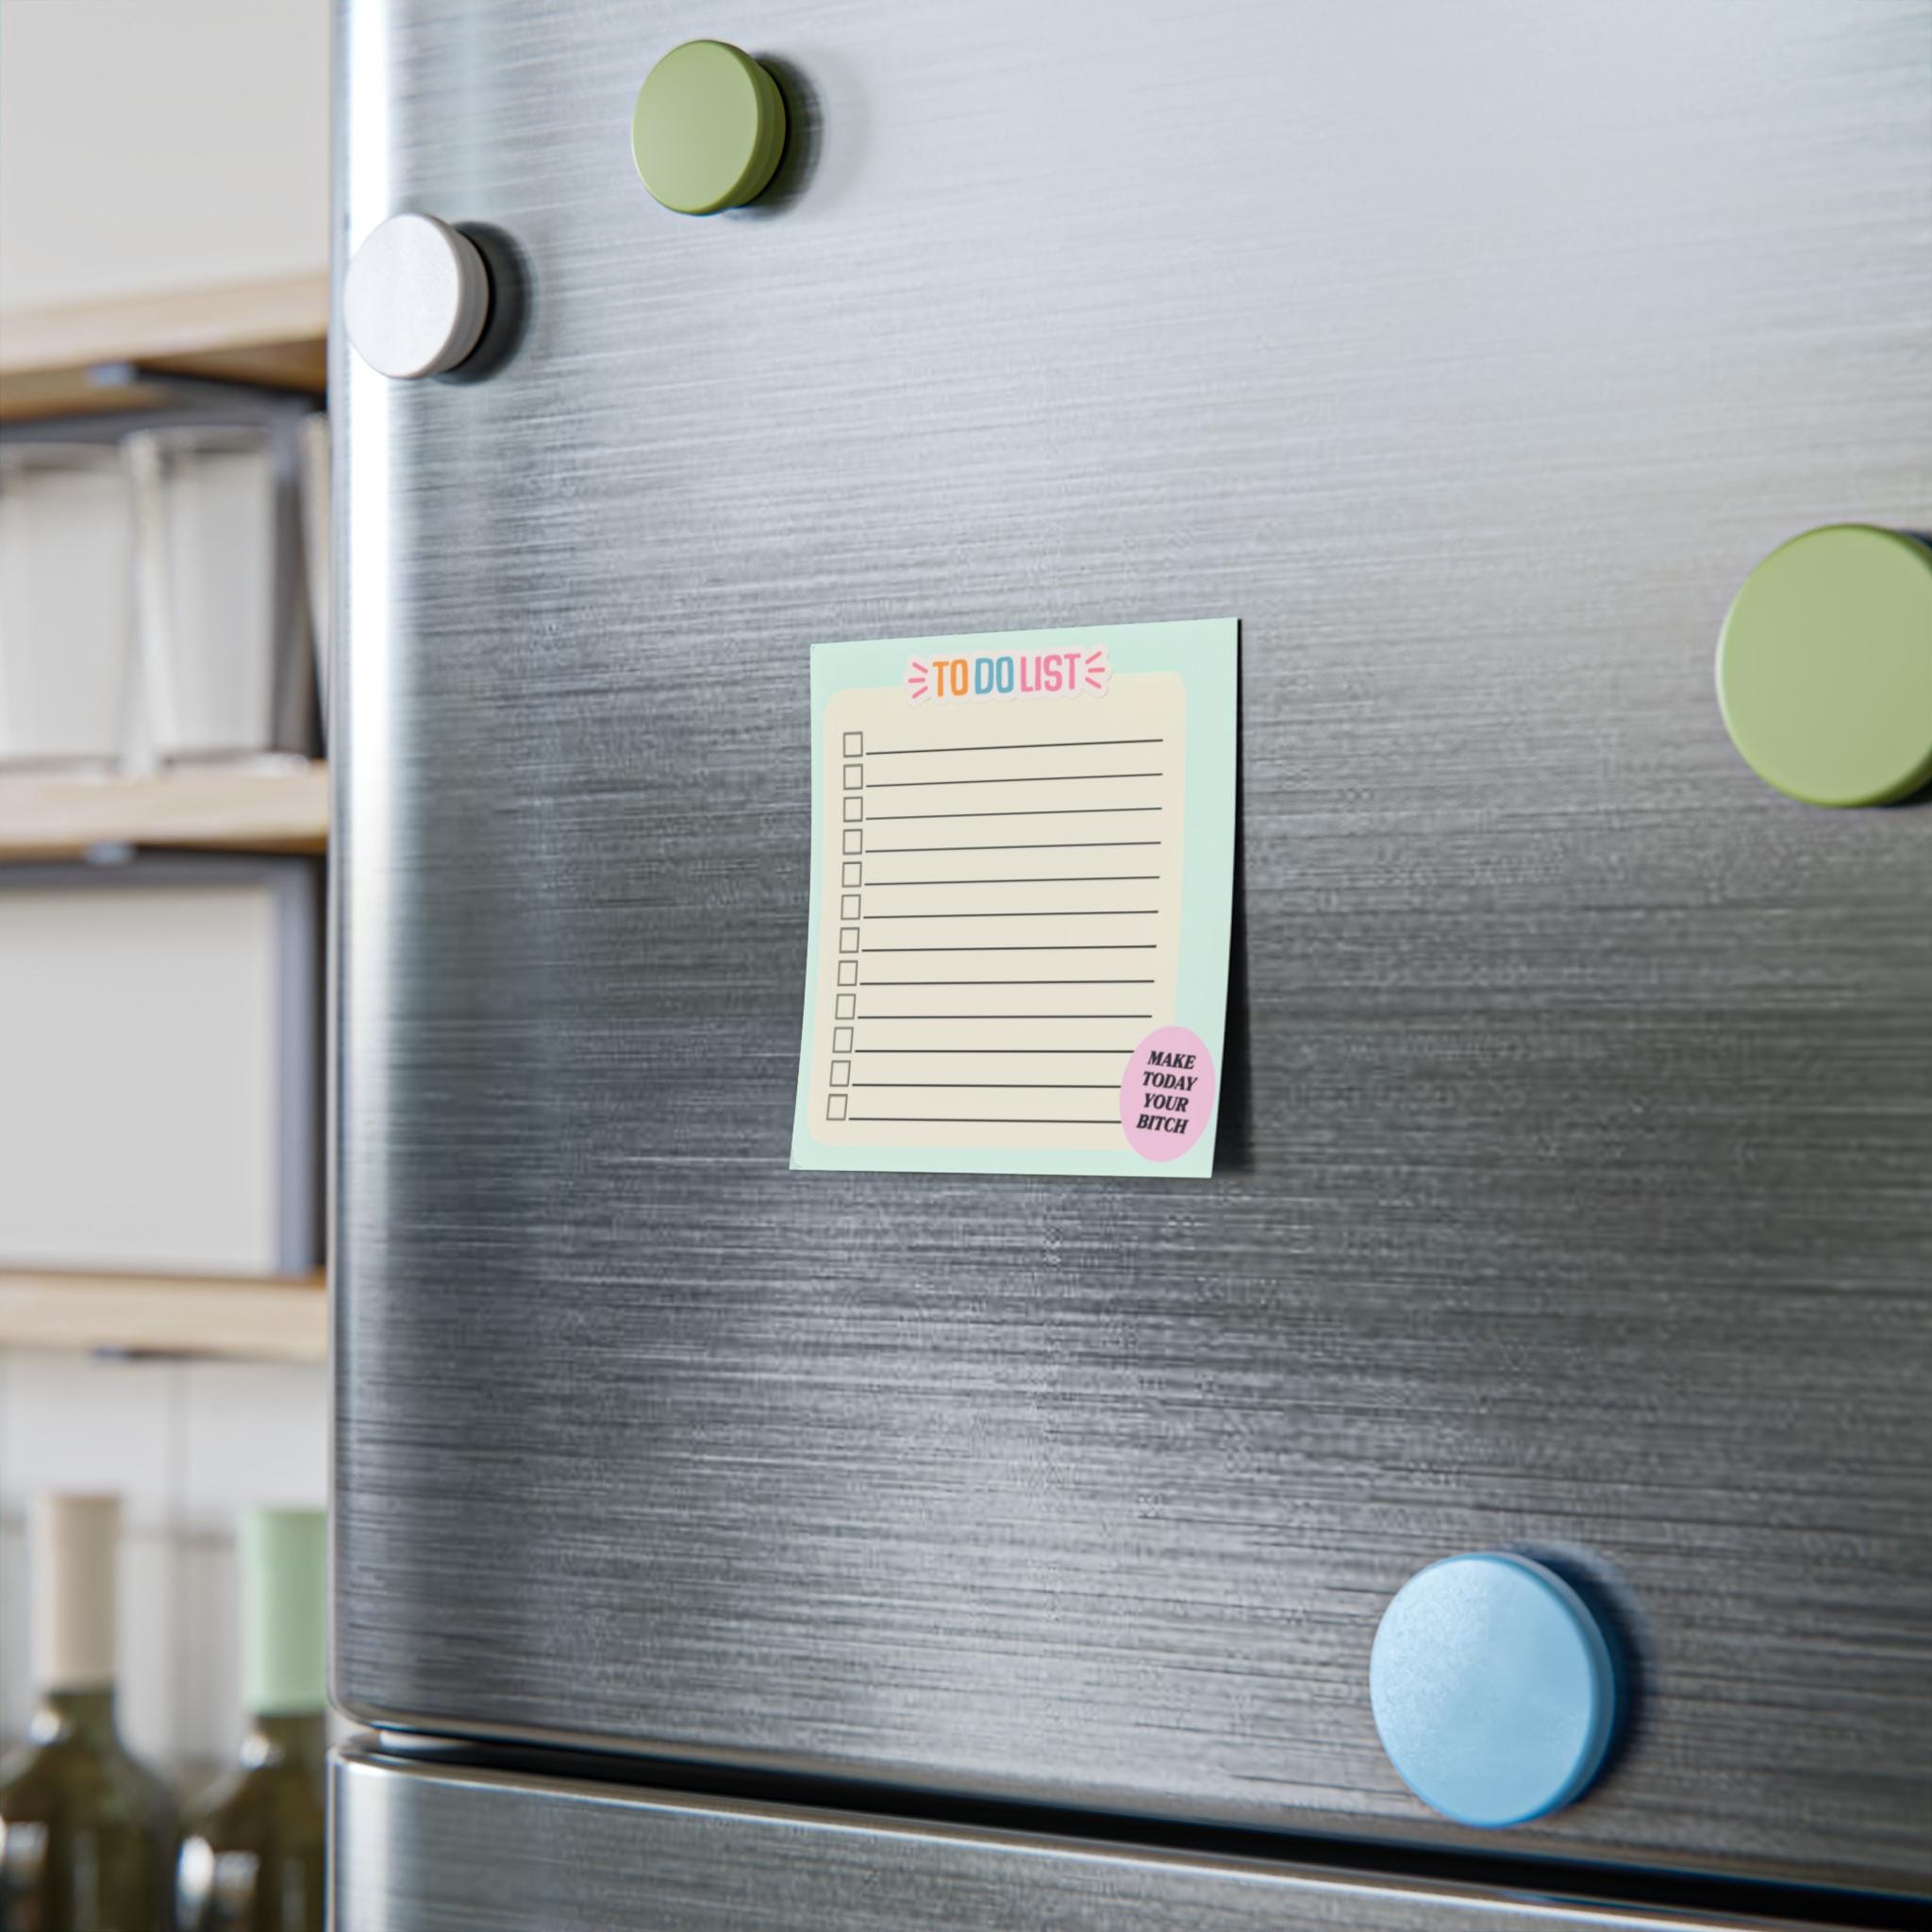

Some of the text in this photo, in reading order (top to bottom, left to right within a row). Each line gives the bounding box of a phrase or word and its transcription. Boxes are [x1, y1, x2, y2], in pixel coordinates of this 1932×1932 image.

[932, 653, 1081, 697] TO DO LIST
[1147, 1050, 1196, 1070] MAKE
[1142, 1071, 1198, 1091] TODAY
[1143, 1092, 1189, 1112] YOUR
[1136, 1113, 1190, 1134] BITCH
